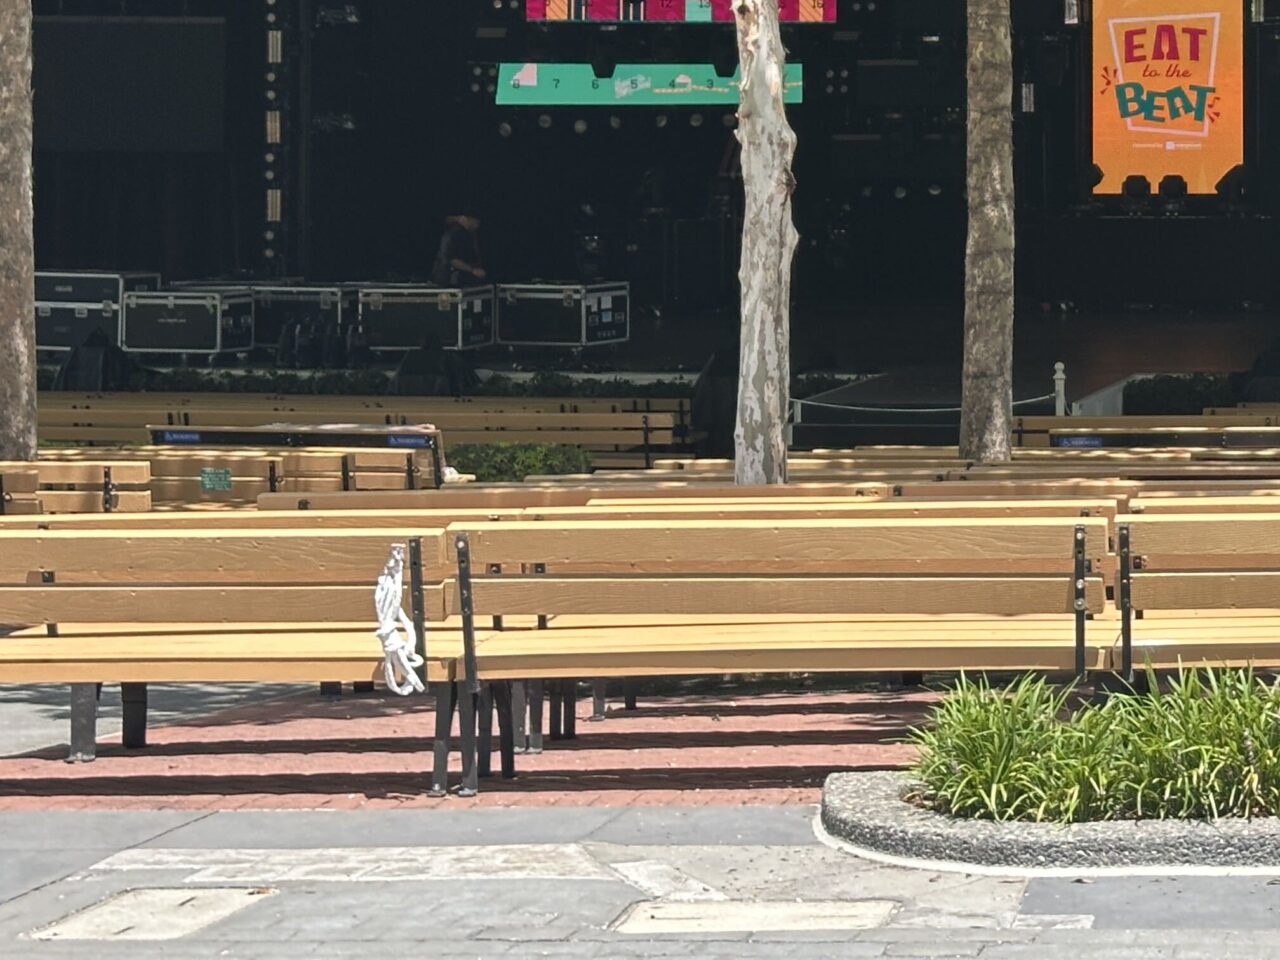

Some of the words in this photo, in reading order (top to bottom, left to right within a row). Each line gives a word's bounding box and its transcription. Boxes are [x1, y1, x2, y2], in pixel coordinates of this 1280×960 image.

[1125, 25, 1207, 63] EAT
[553, 78, 560, 89] 7
[591, 79, 600, 89] 6
[630, 79, 638, 89] 5
[668, 79, 676, 89] 4
[706, 79, 714, 89] 3
[1142, 64, 1161, 78] to
[1166, 63, 1192, 78] the
[1115, 82, 1215, 123] BEAT
